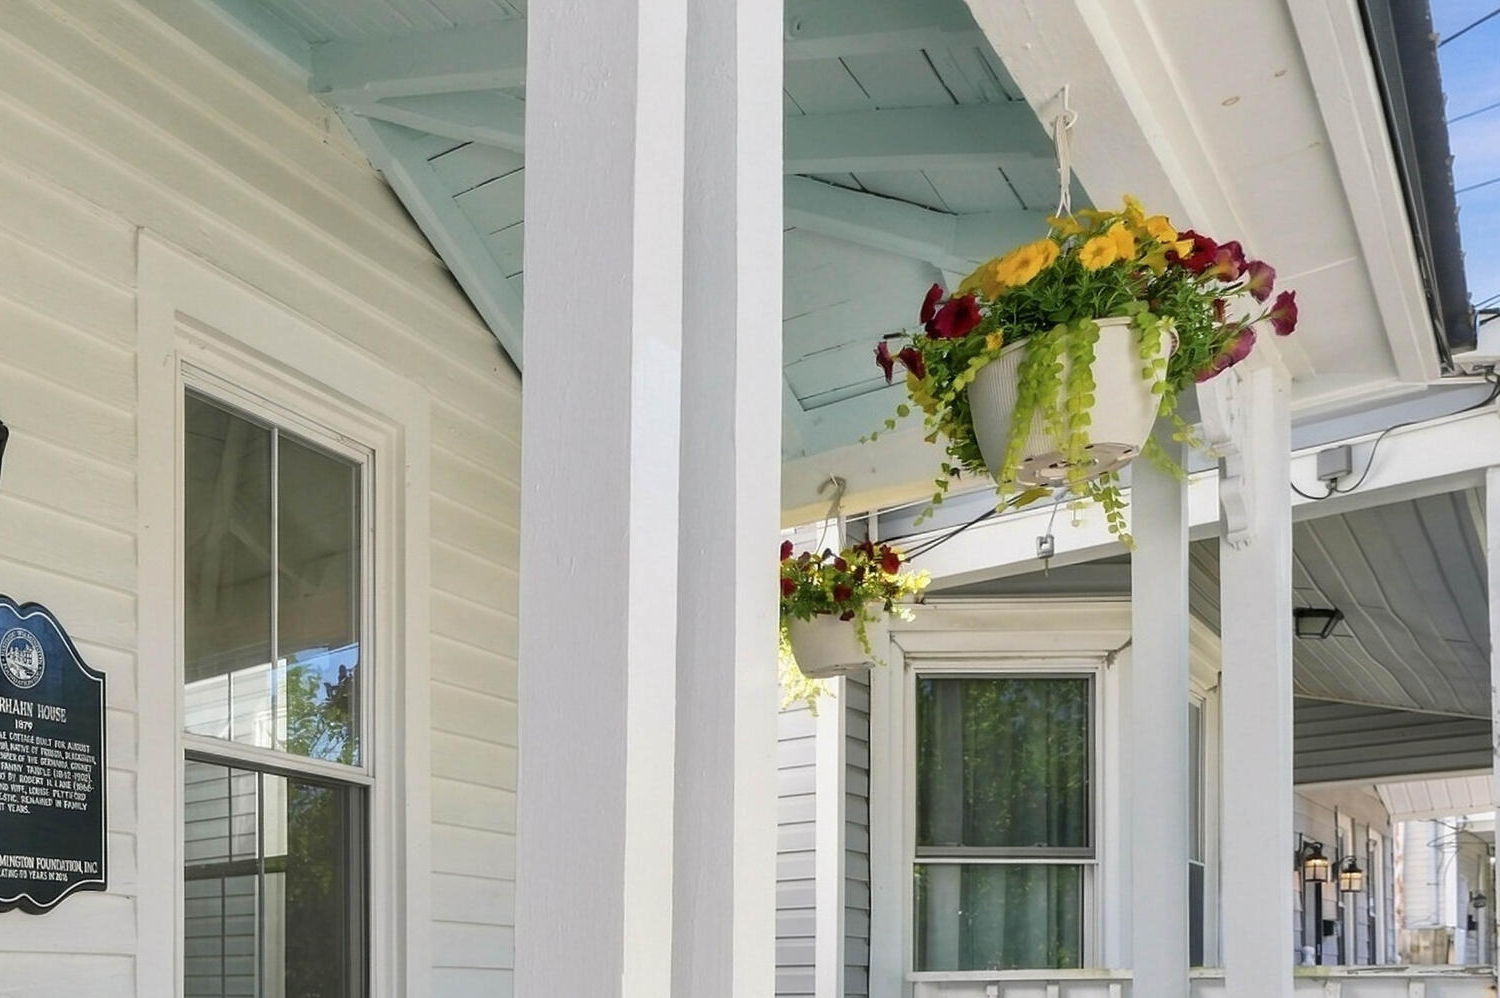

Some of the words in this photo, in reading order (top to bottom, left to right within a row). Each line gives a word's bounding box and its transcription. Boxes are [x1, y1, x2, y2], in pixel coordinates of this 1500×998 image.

[37, 704, 66, 723] HOUSE
[15, 719, 33, 731] 1879
[36, 736, 52, 747] BUILT
[54, 740, 66, 749] FOR
[28, 870, 48, 880] YEARS
